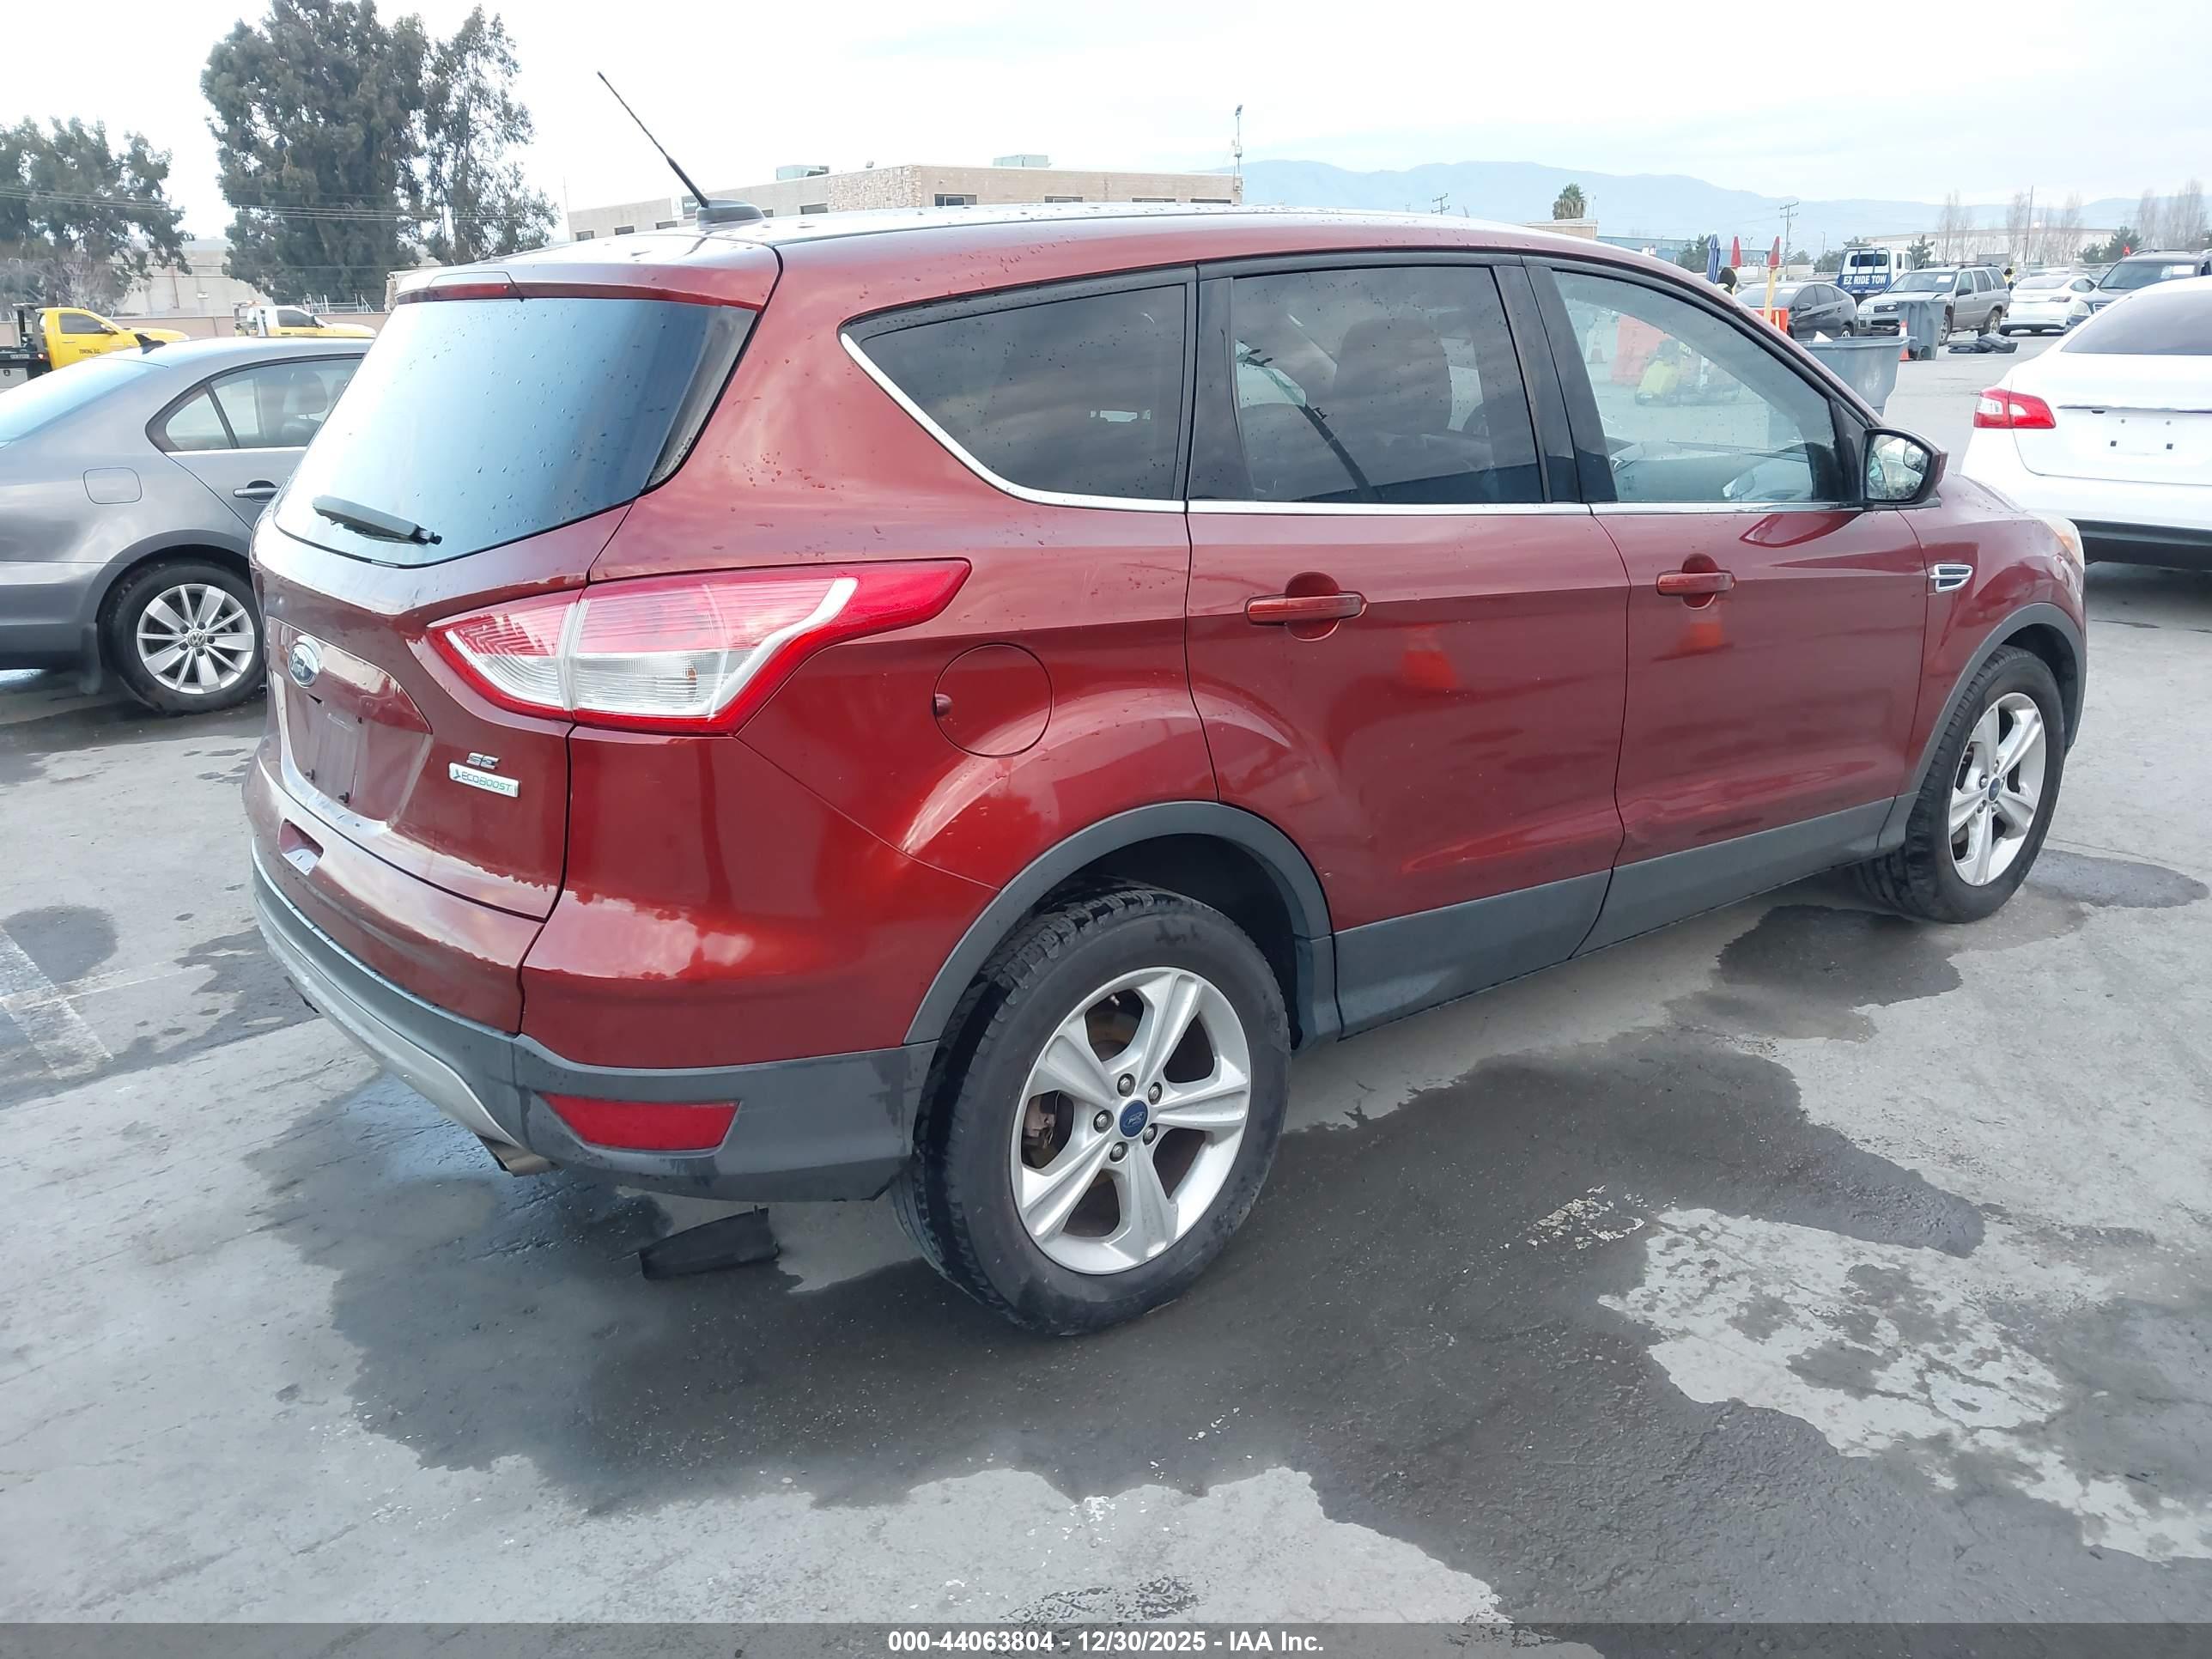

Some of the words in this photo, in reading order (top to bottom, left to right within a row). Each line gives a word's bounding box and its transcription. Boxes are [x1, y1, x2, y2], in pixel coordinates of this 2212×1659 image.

[1843, 276, 1853, 285] EZ
[1854, 275, 1870, 285] RIDE
[1871, 274, 1887, 284] TOW
[466, 752, 500, 769] SE
[461, 771, 513, 792] ECOBOOST
